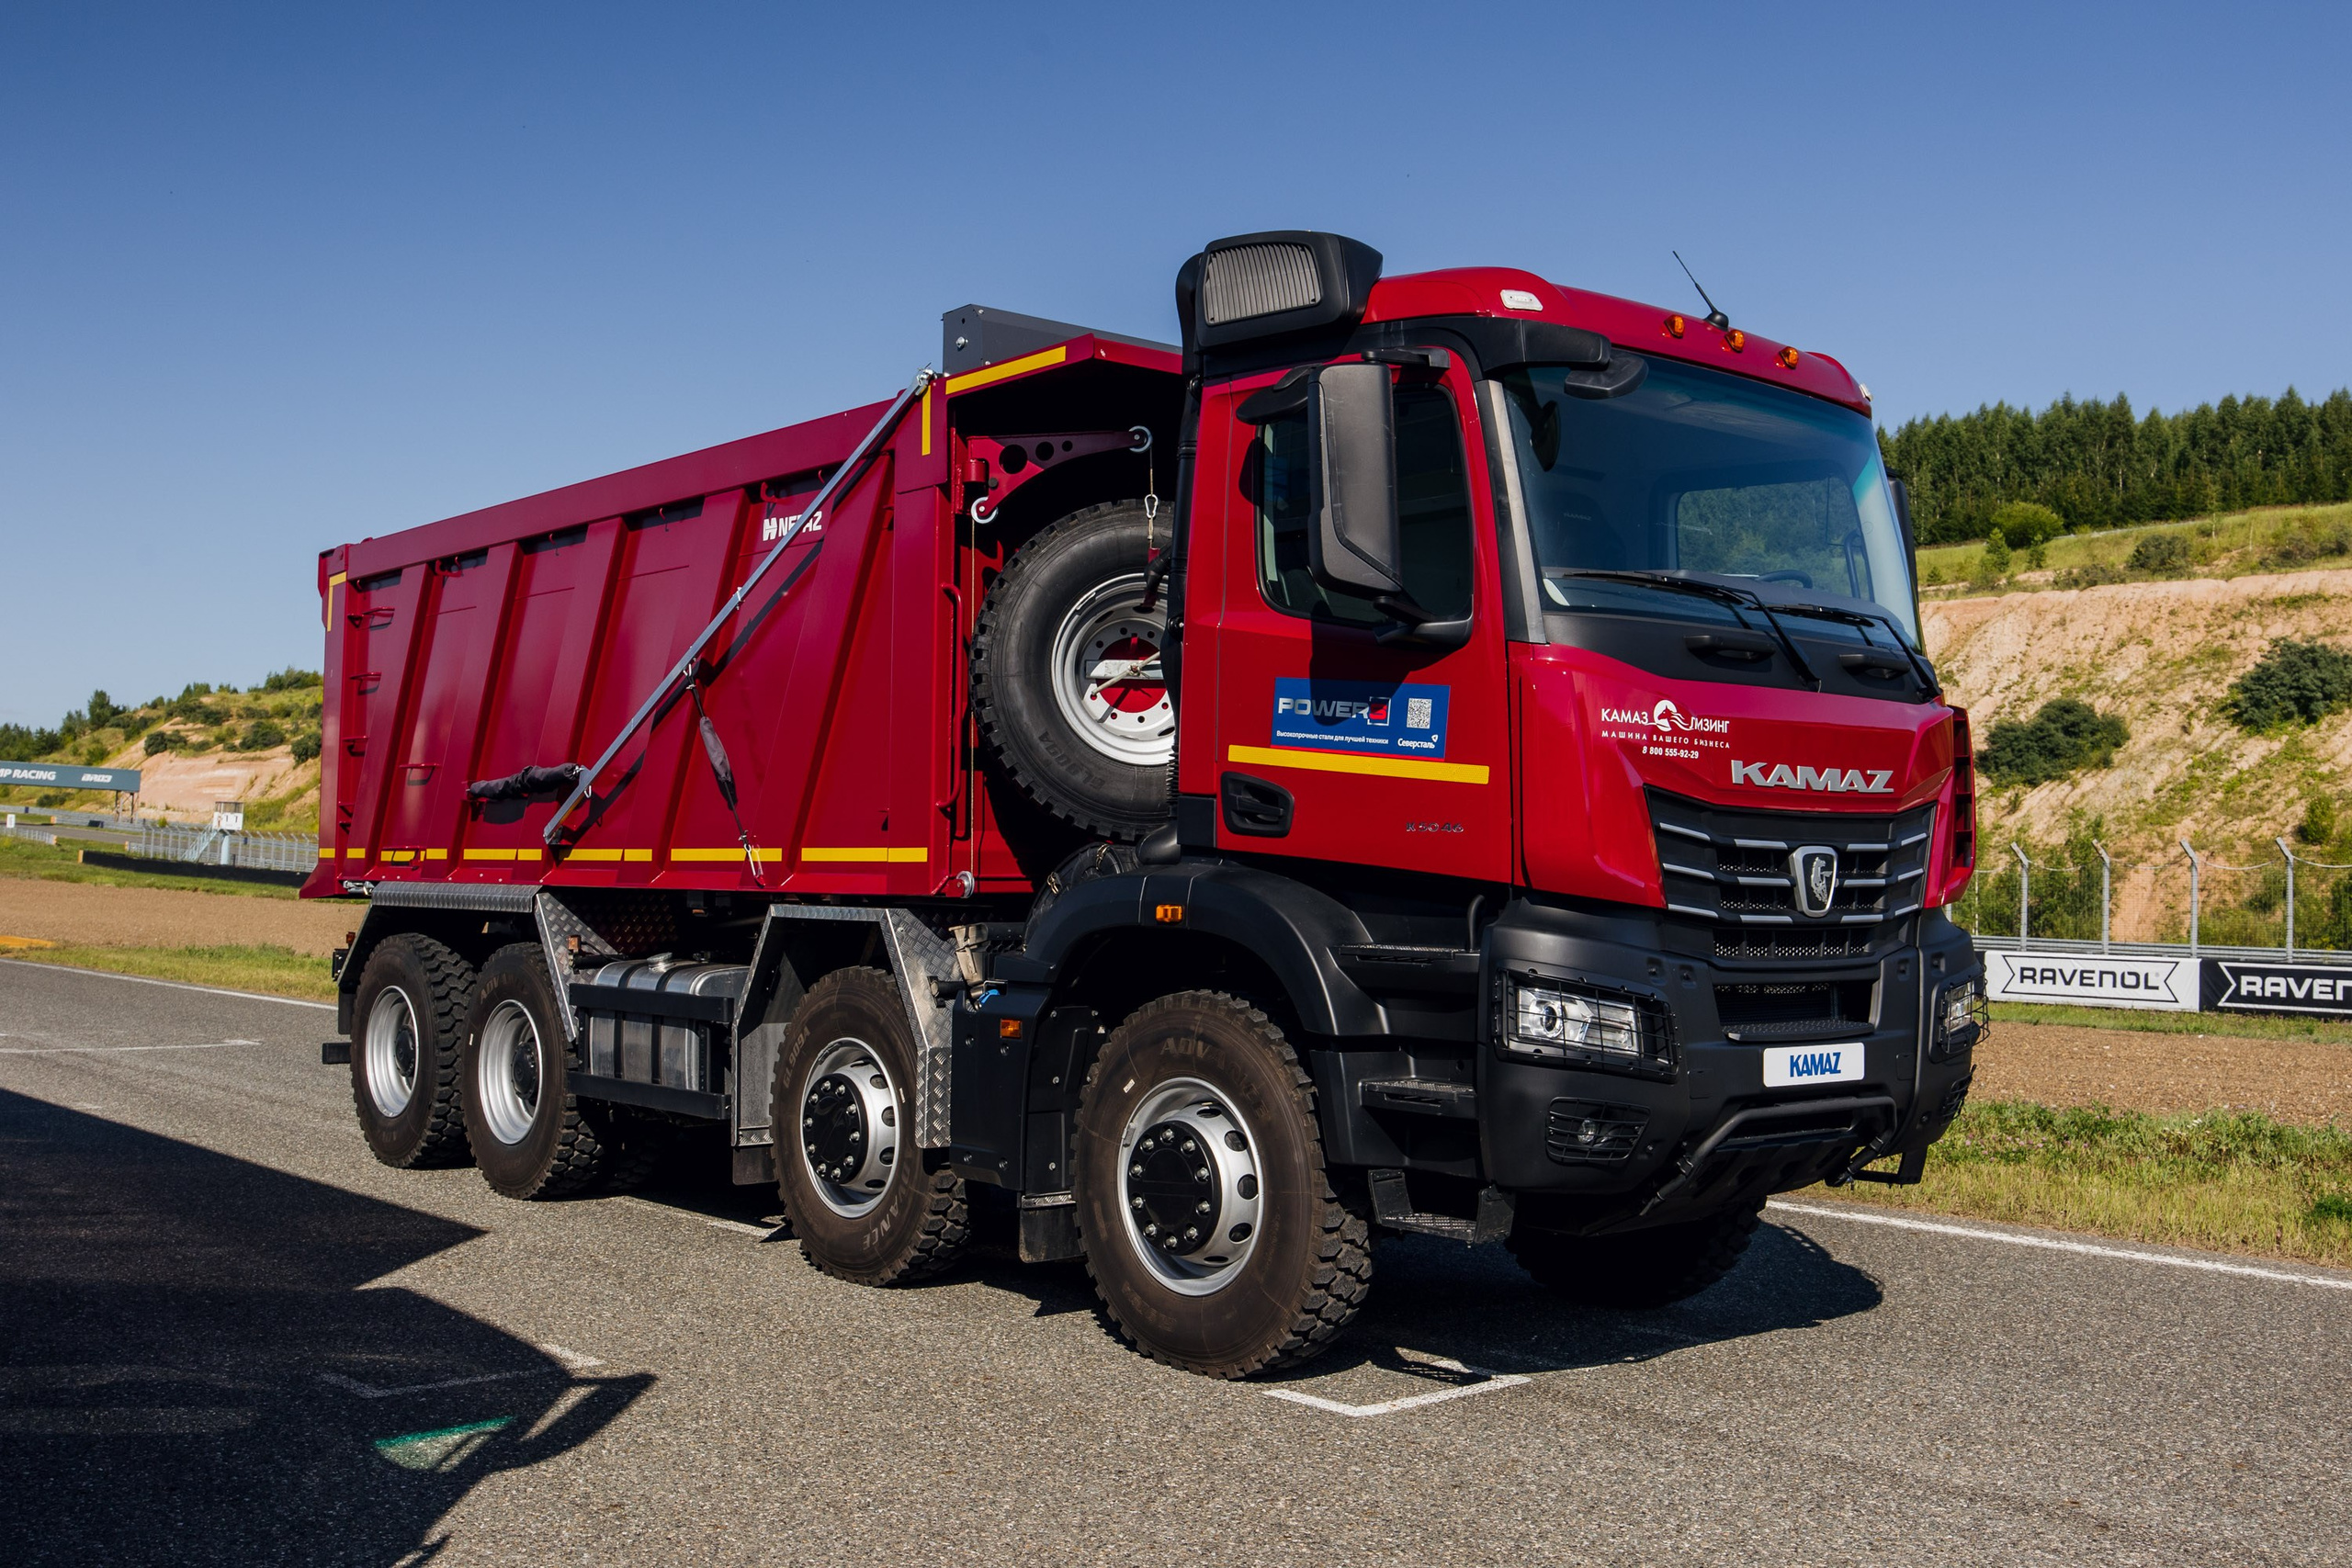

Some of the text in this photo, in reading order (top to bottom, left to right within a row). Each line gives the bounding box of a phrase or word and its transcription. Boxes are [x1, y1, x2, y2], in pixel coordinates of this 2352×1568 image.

[778, 511, 822, 537] NEAZ
[1601, 708, 1649, 724] КАМАЗ
[1276, 730, 1318, 739] Высокопрочные
[1601, 730, 1730, 749] МАШИНА ВАШЕГО БИЗНЕСА
[1397, 738, 1435, 750] Северсталь
[1642, 746, 1700, 759] 8 800 555-92-29
[12, 768, 57, 781] RACING
[1731, 760, 1894, 793] KAMAZ
[2019, 966, 2160, 990] RAVENOL
[1790, 1052, 1841, 1077] KAMAZ
